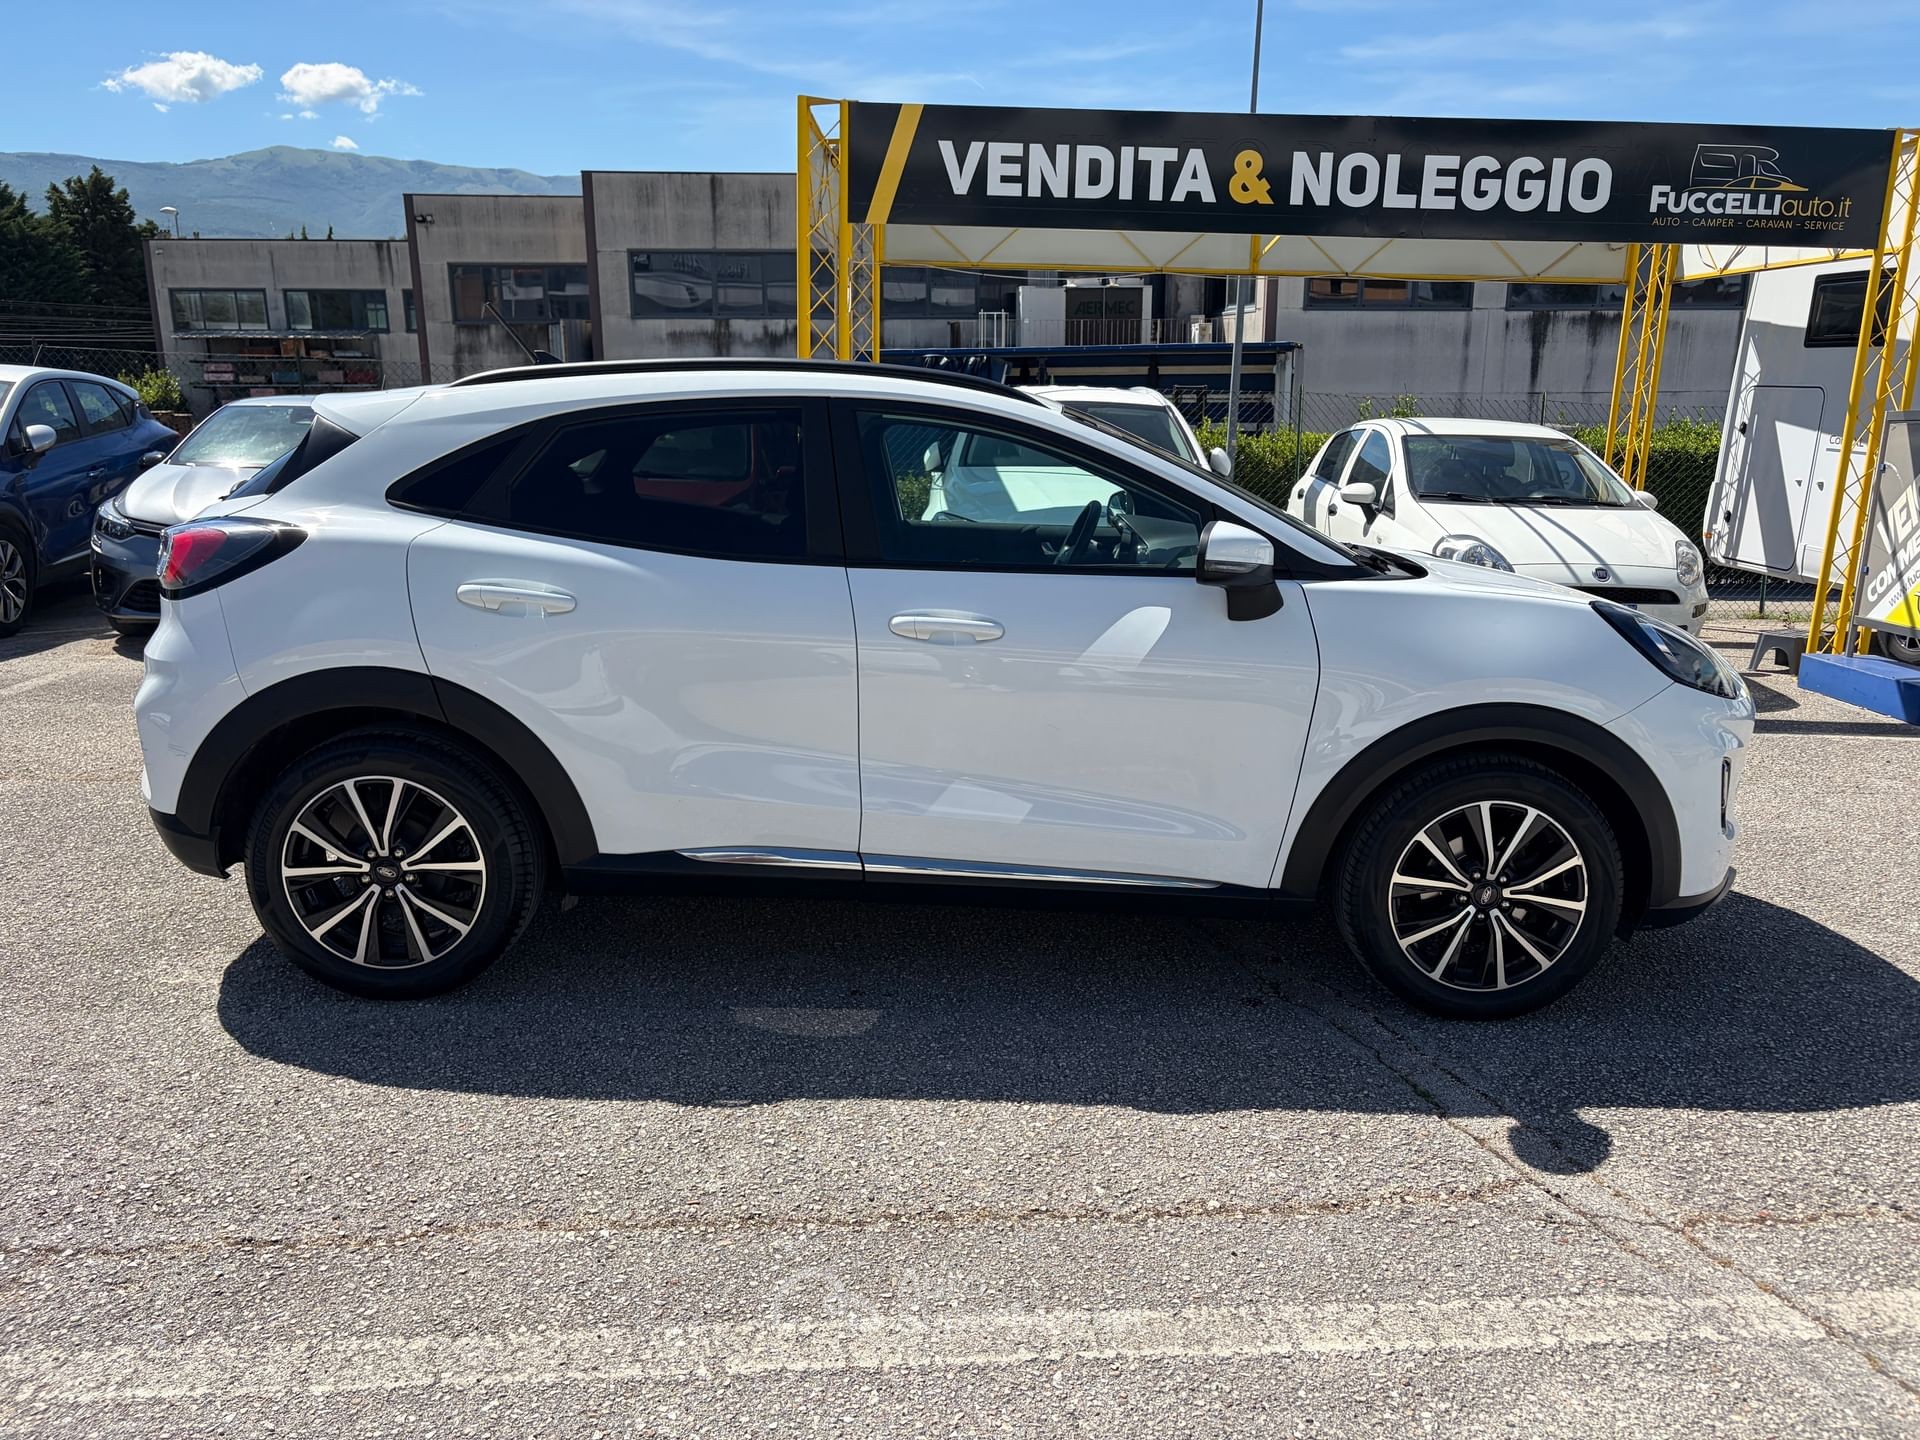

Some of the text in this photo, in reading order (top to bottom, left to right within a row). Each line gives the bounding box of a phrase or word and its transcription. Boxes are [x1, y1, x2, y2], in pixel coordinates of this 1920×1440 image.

[938, 140, 1613, 214] VENDITA & NOLEGGIO
[1649, 184, 1852, 218] FUCCELLIauto.it
[1651, 217, 1680, 226] AUTO
[1692, 217, 1734, 228] CAMPER
[1745, 219, 1793, 229] CARAVAN
[1803, 220, 1845, 231] SERVICE
[1074, 300, 1135, 315] AERMEC
